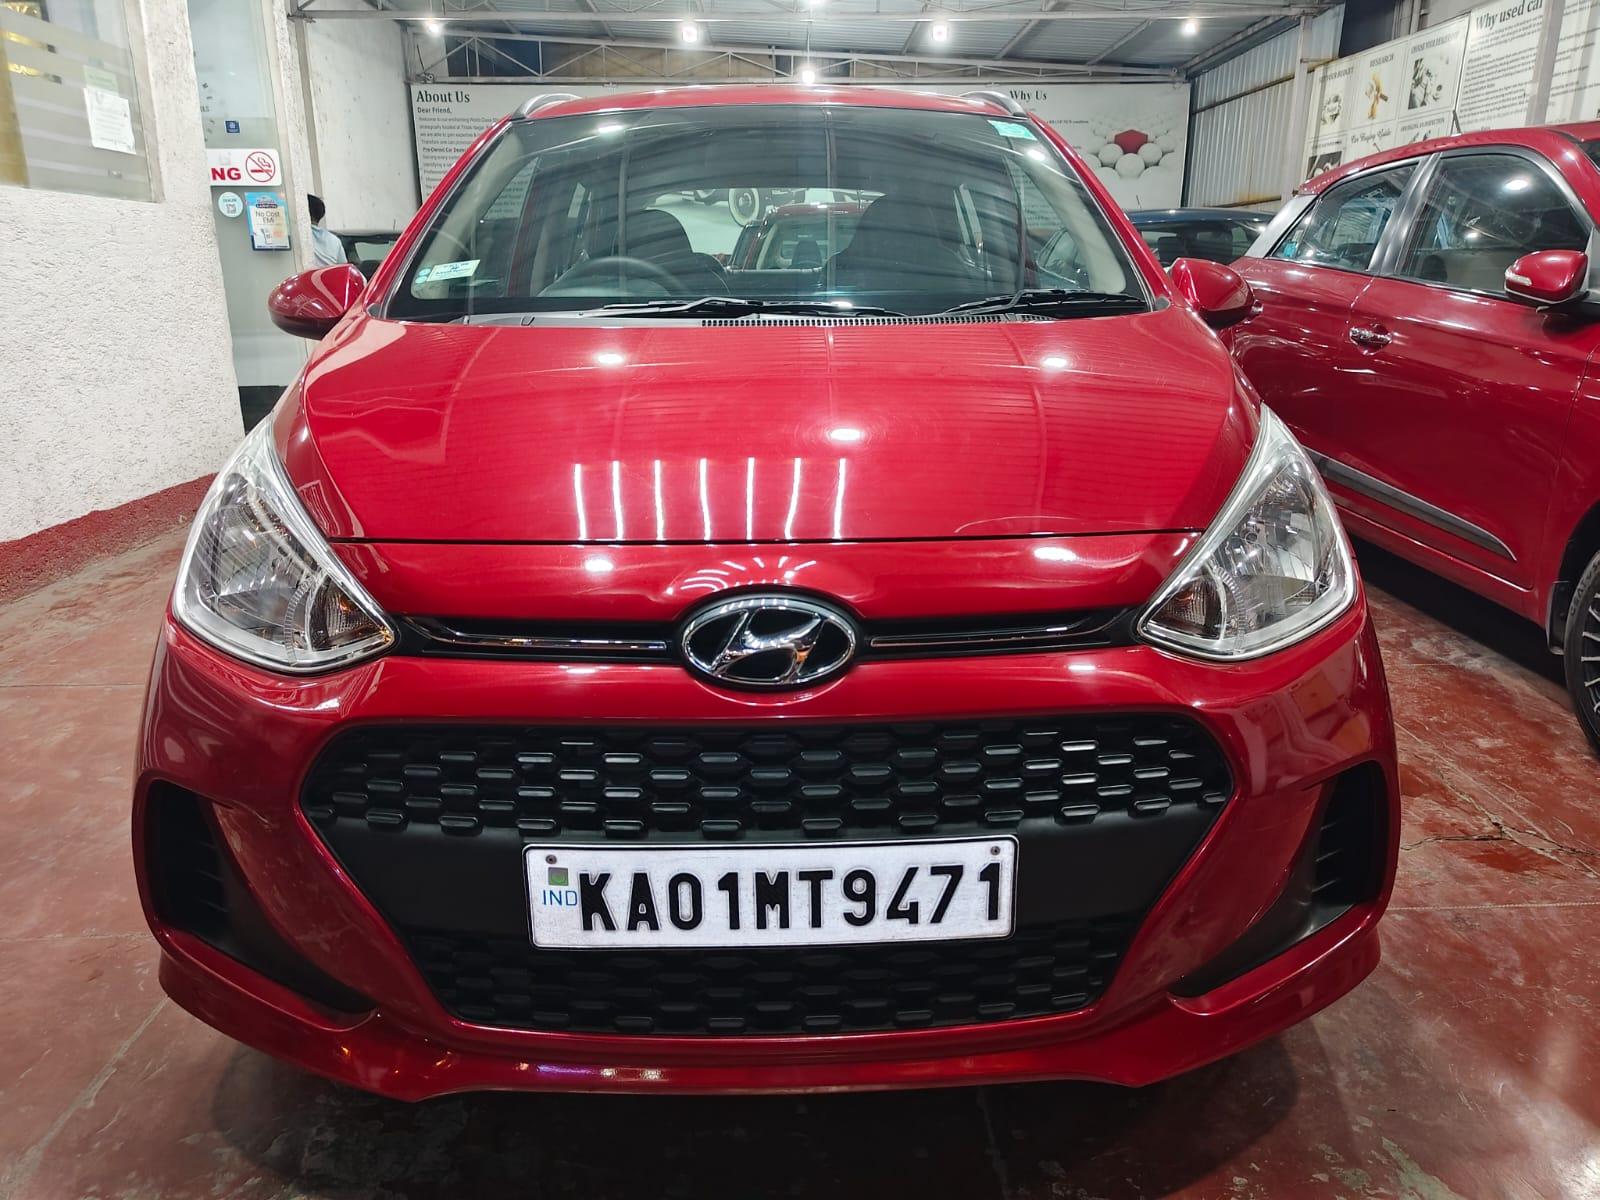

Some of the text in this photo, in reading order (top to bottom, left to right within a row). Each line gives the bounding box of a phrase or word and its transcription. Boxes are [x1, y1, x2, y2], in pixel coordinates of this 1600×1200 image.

[1476, 12, 1498, 31] Why
[1499, 0, 1525, 23] used
[416, 90, 470, 103] About Us
[1009, 89, 1048, 103] Why Us
[542, 889, 578, 907] IND
[579, 862, 1001, 931] KA01MT9471
